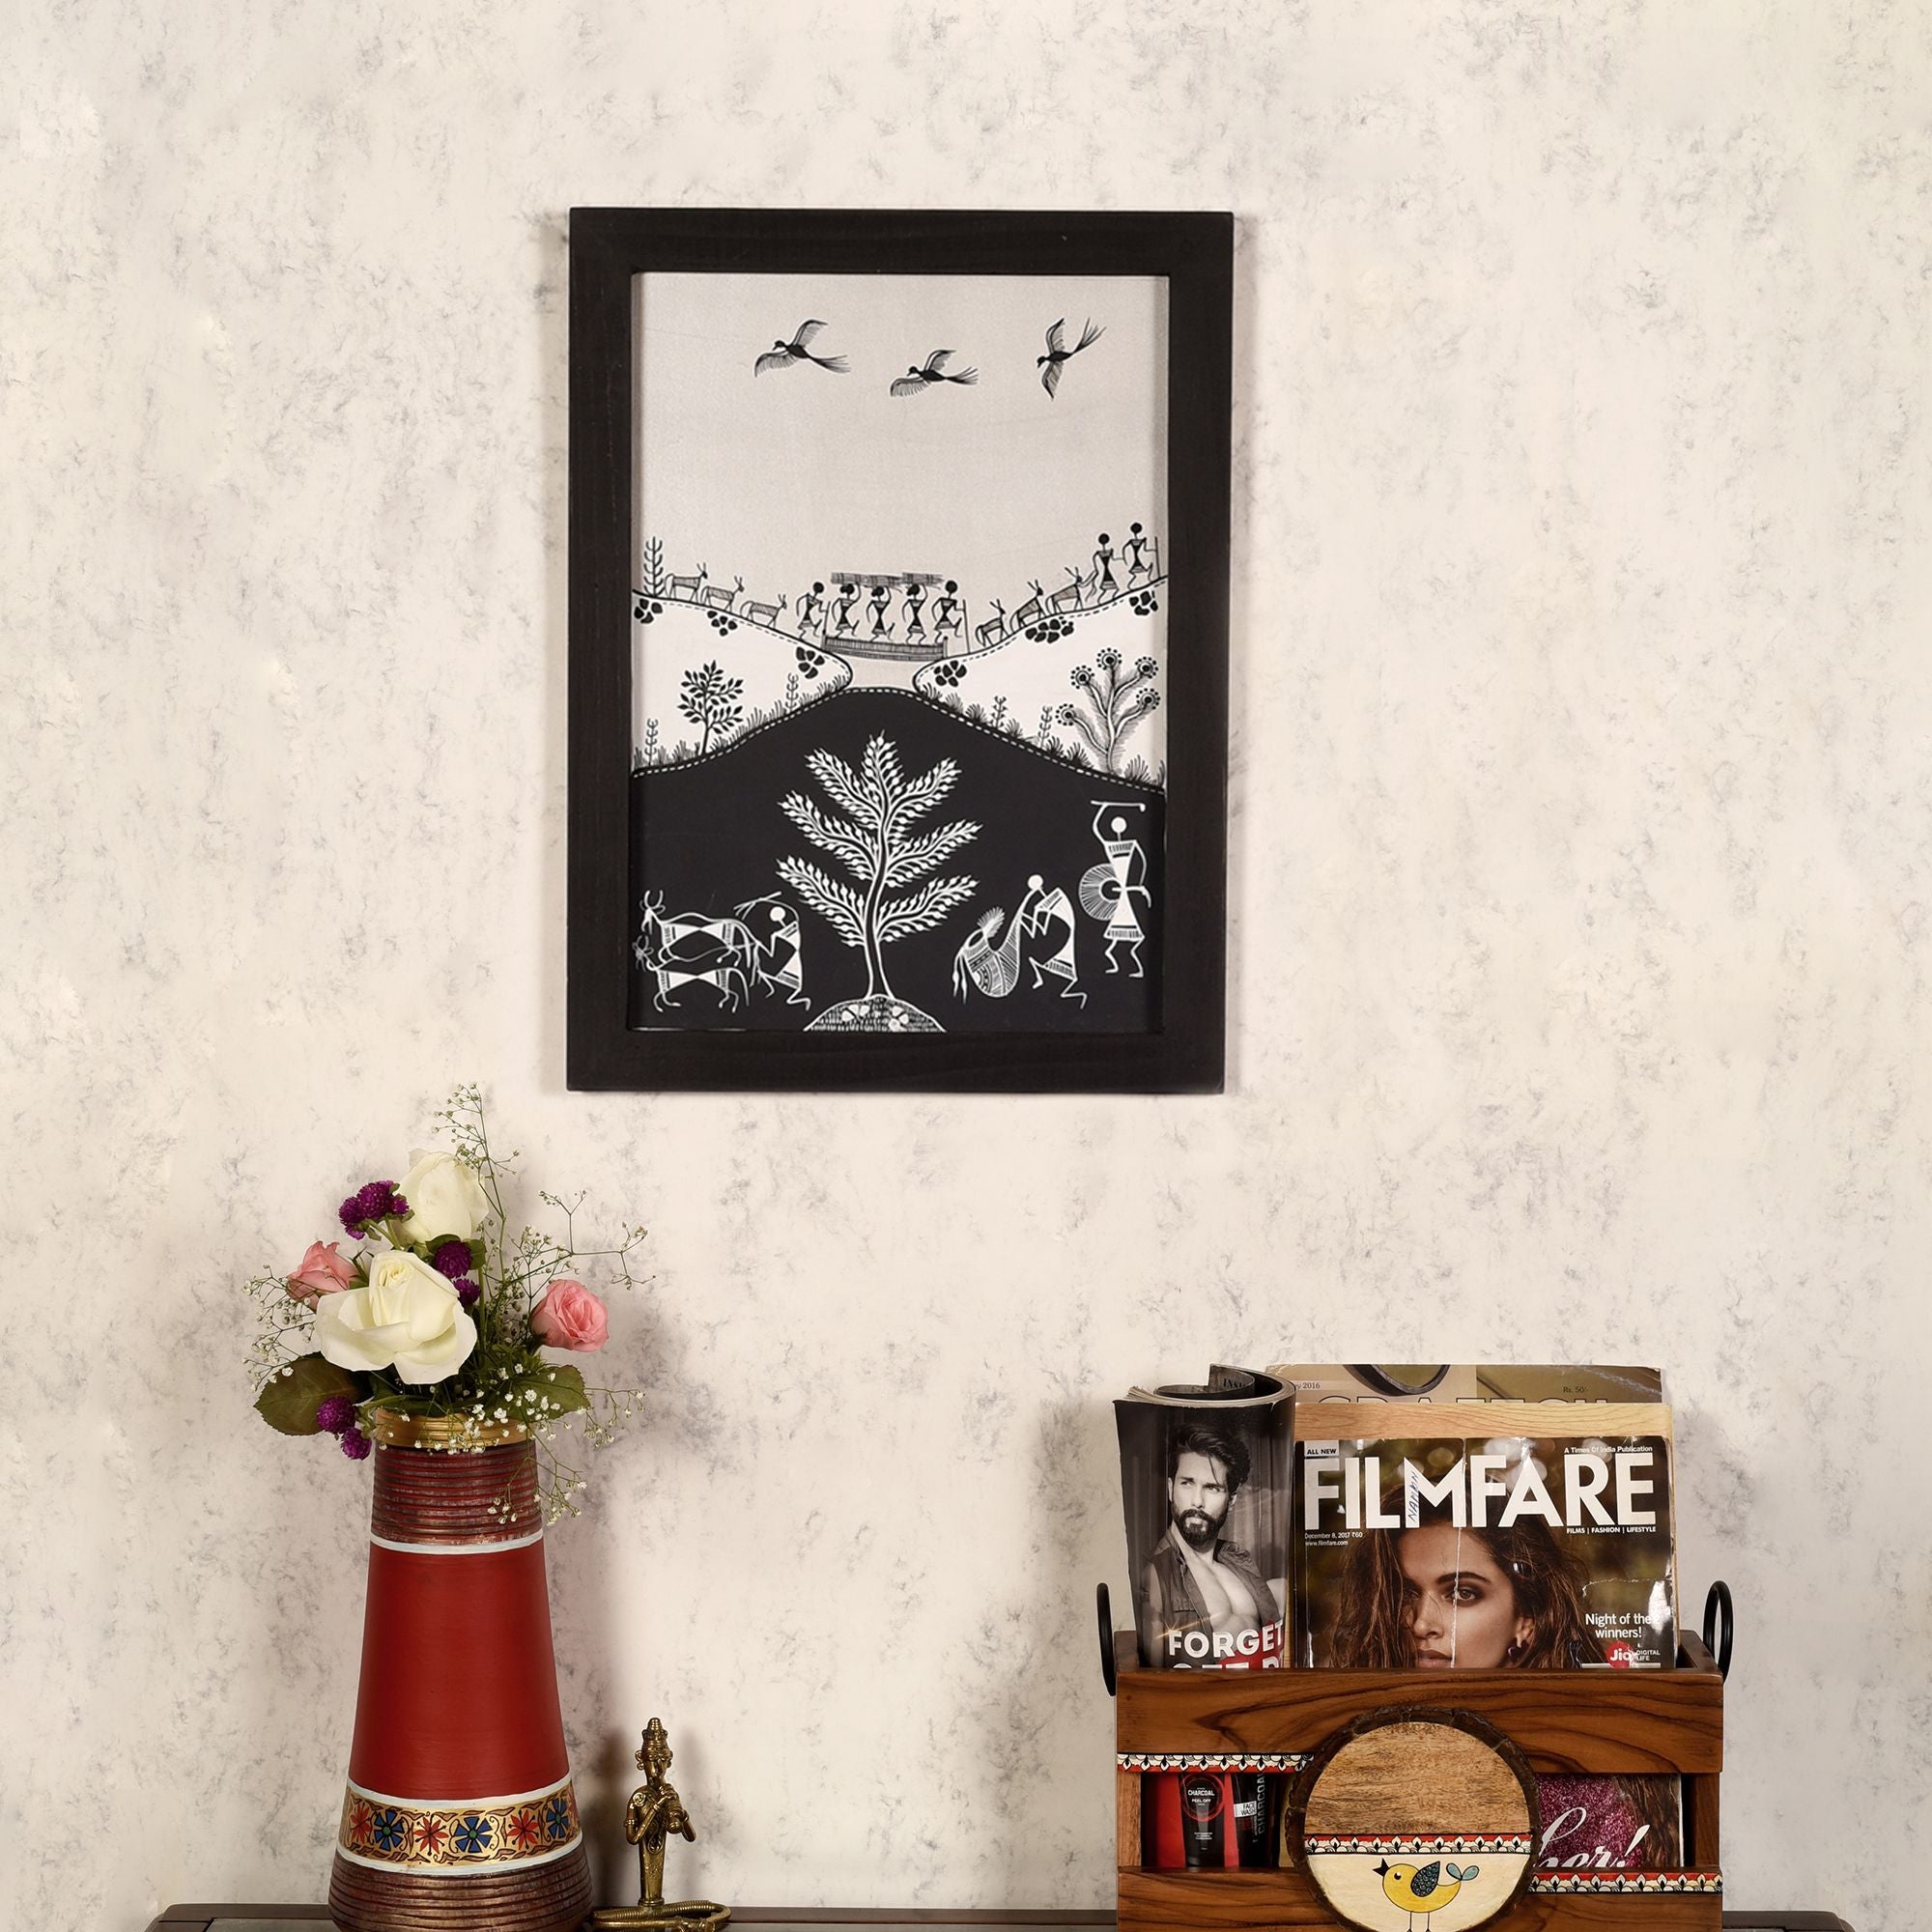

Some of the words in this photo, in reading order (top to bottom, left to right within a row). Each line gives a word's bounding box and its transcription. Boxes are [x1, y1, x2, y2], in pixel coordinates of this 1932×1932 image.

[1304, 1454, 1656, 1530] FILMFARE
[1585, 1613, 1616, 1627] Night
[1619, 1613, 1631, 1625] of
[1634, 1613, 1652, 1625] the
[1595, 1627, 1642, 1638] winners!
[1169, 1620, 1283, 1659] FORGET
